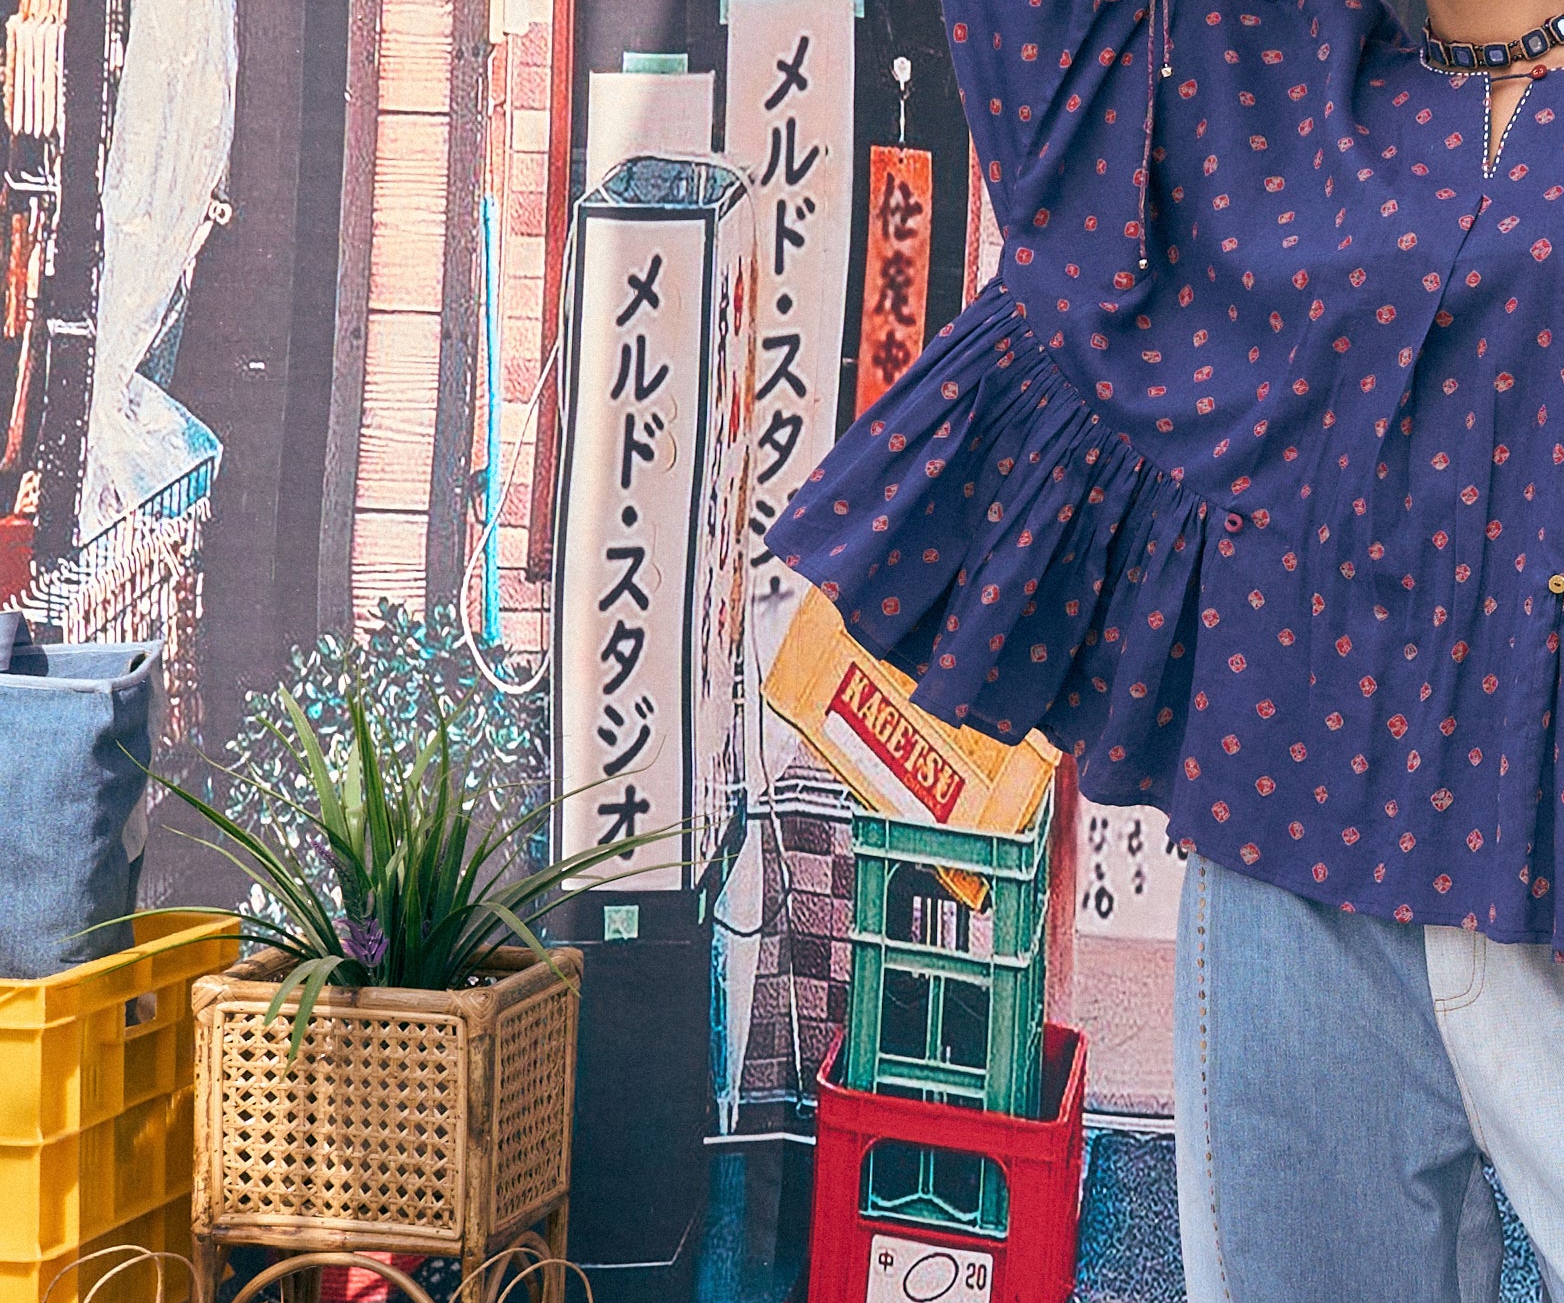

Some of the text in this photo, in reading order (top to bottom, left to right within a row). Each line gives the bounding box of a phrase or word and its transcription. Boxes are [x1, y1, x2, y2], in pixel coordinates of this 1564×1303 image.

[597, 254, 669, 861] メルド・スタジオ
[842, 668, 960, 804] KAGETSU
[965, 1262, 987, 1290] 20
